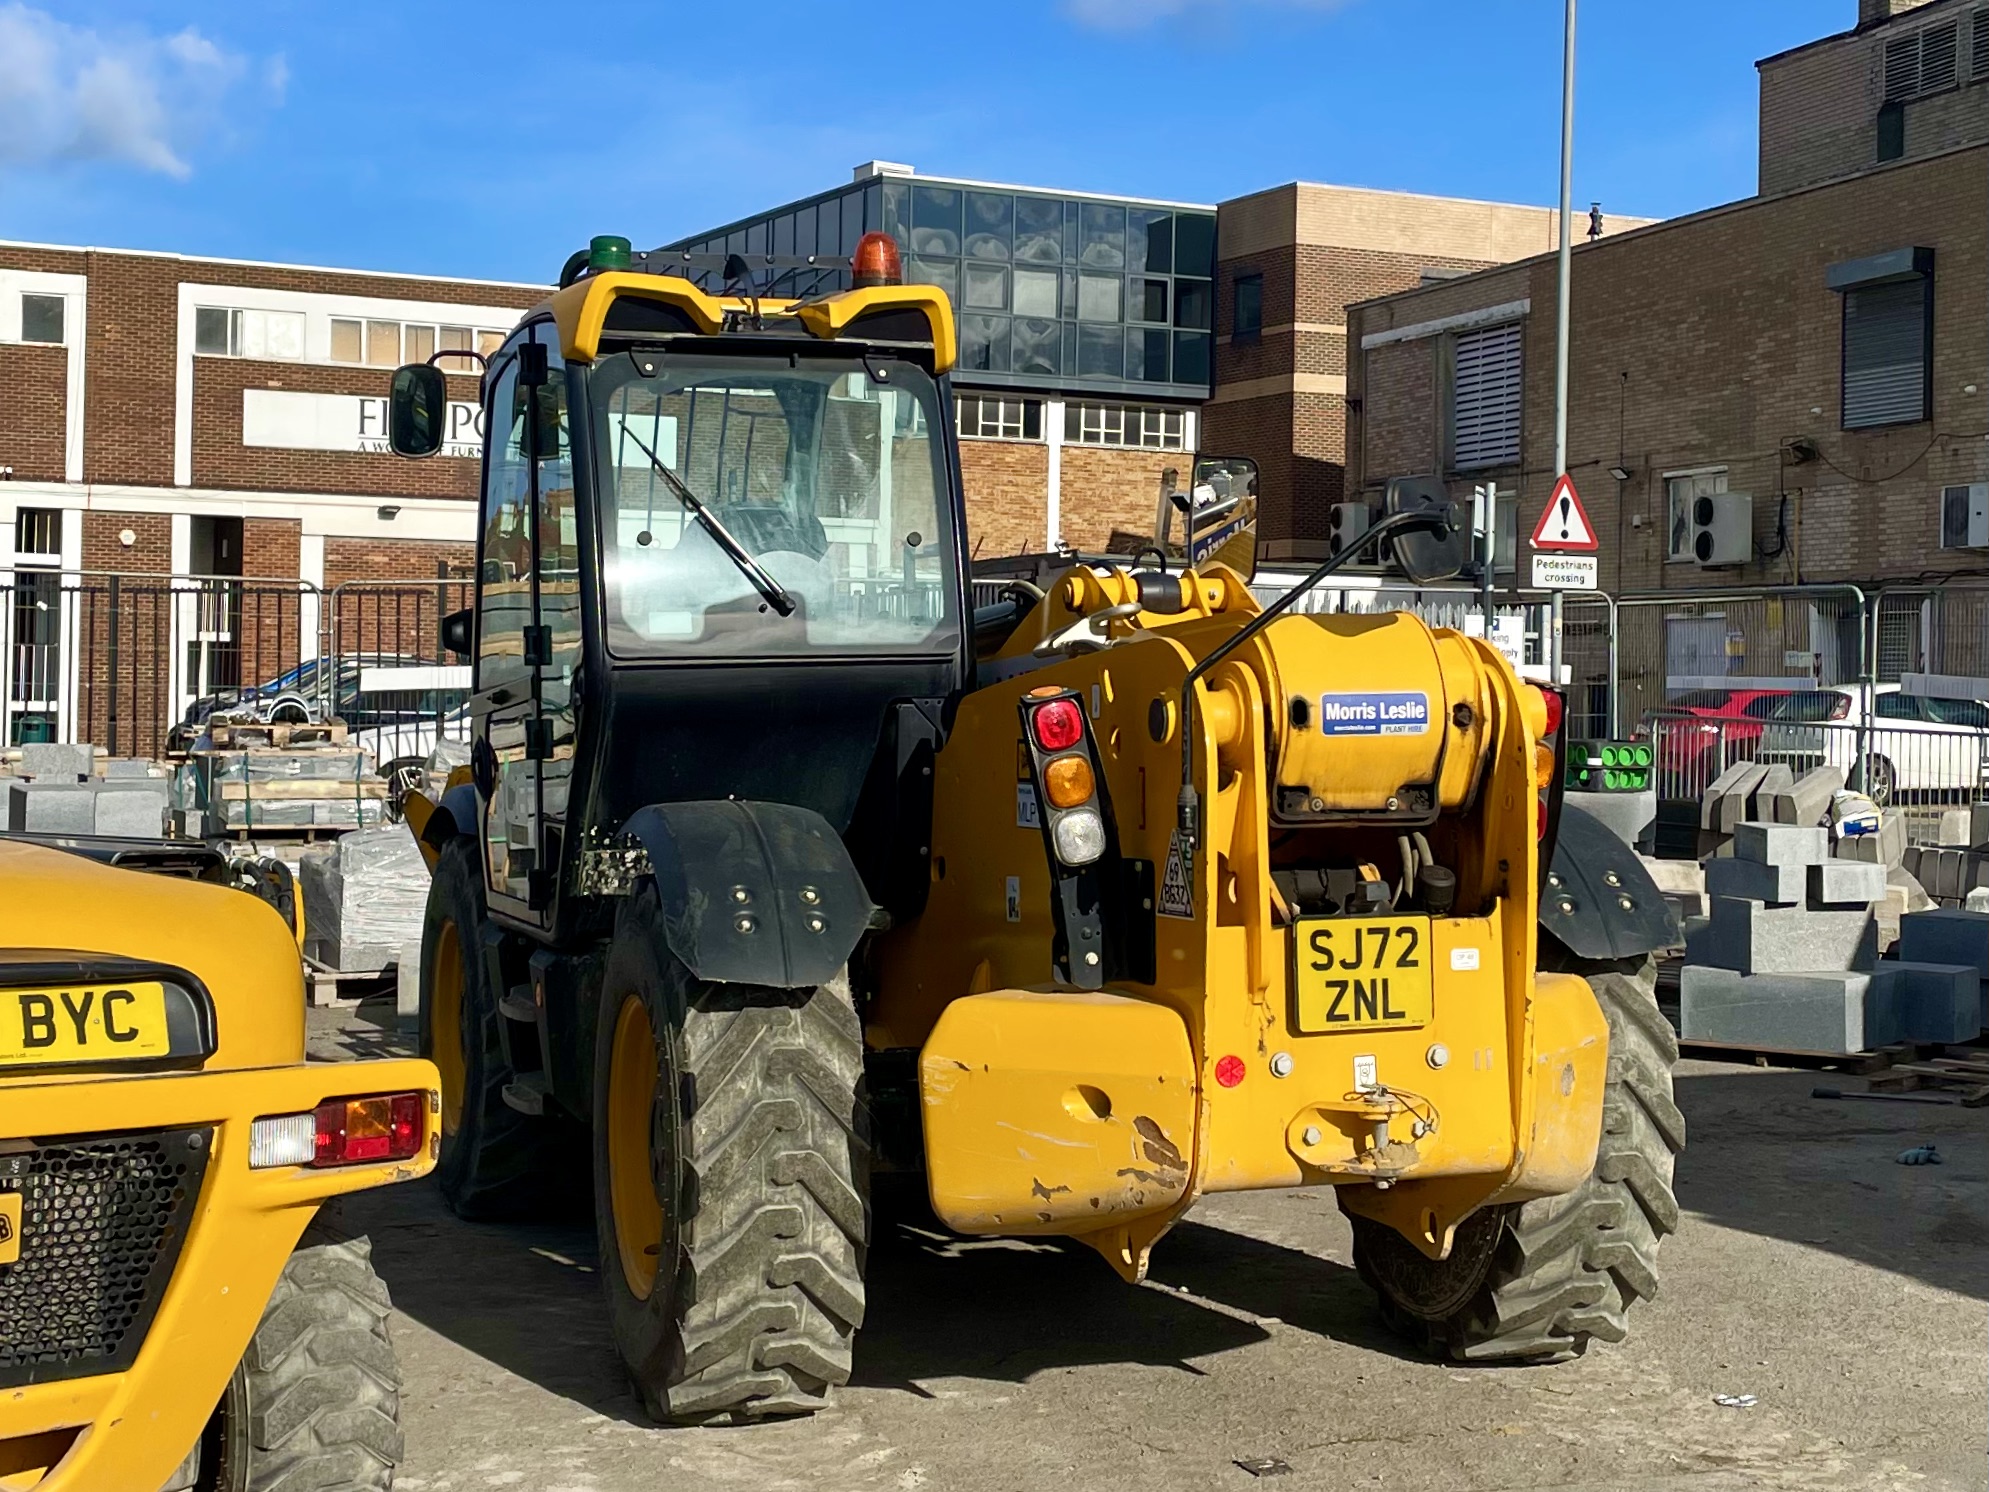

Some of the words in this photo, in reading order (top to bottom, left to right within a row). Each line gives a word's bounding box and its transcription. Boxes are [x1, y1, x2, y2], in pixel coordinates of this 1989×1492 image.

[358, 442, 367, 452] A
[1536, 558, 1593, 570] Pedestrians
[1545, 574, 1585, 584] crossing
[1326, 702, 1376, 720] Morris
[1380, 701, 1425, 719] Leslie
[1310, 926, 1419, 971] SJ72
[1325, 978, 1406, 1022] ZNL
[18, 990, 139, 1048] BYC
